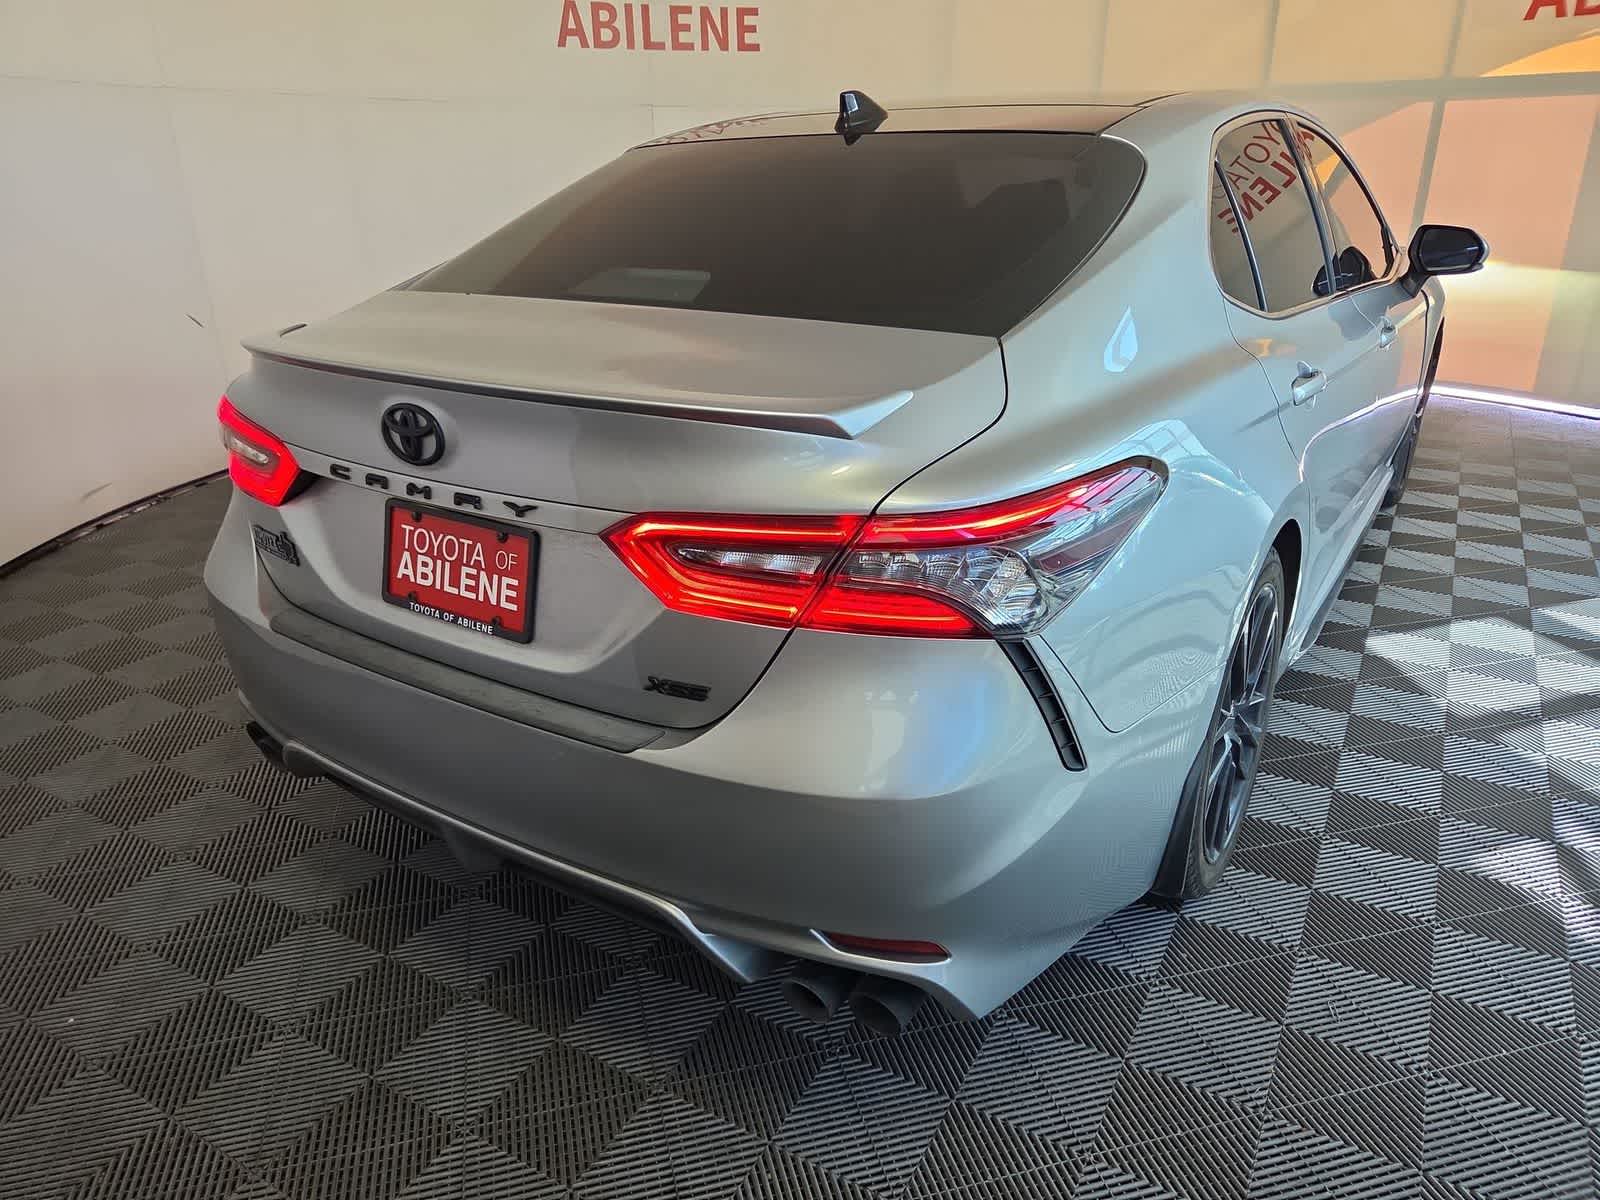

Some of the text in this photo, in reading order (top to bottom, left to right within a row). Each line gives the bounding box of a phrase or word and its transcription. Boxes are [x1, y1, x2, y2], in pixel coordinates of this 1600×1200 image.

[557, 0, 760, 52] ABILENE
[330, 464, 538, 517] CAMRY
[401, 524, 518, 571] TOYOTA OF
[396, 551, 519, 611] ABILENE
[409, 602, 493, 635] TOYOTA OF ABILENE
